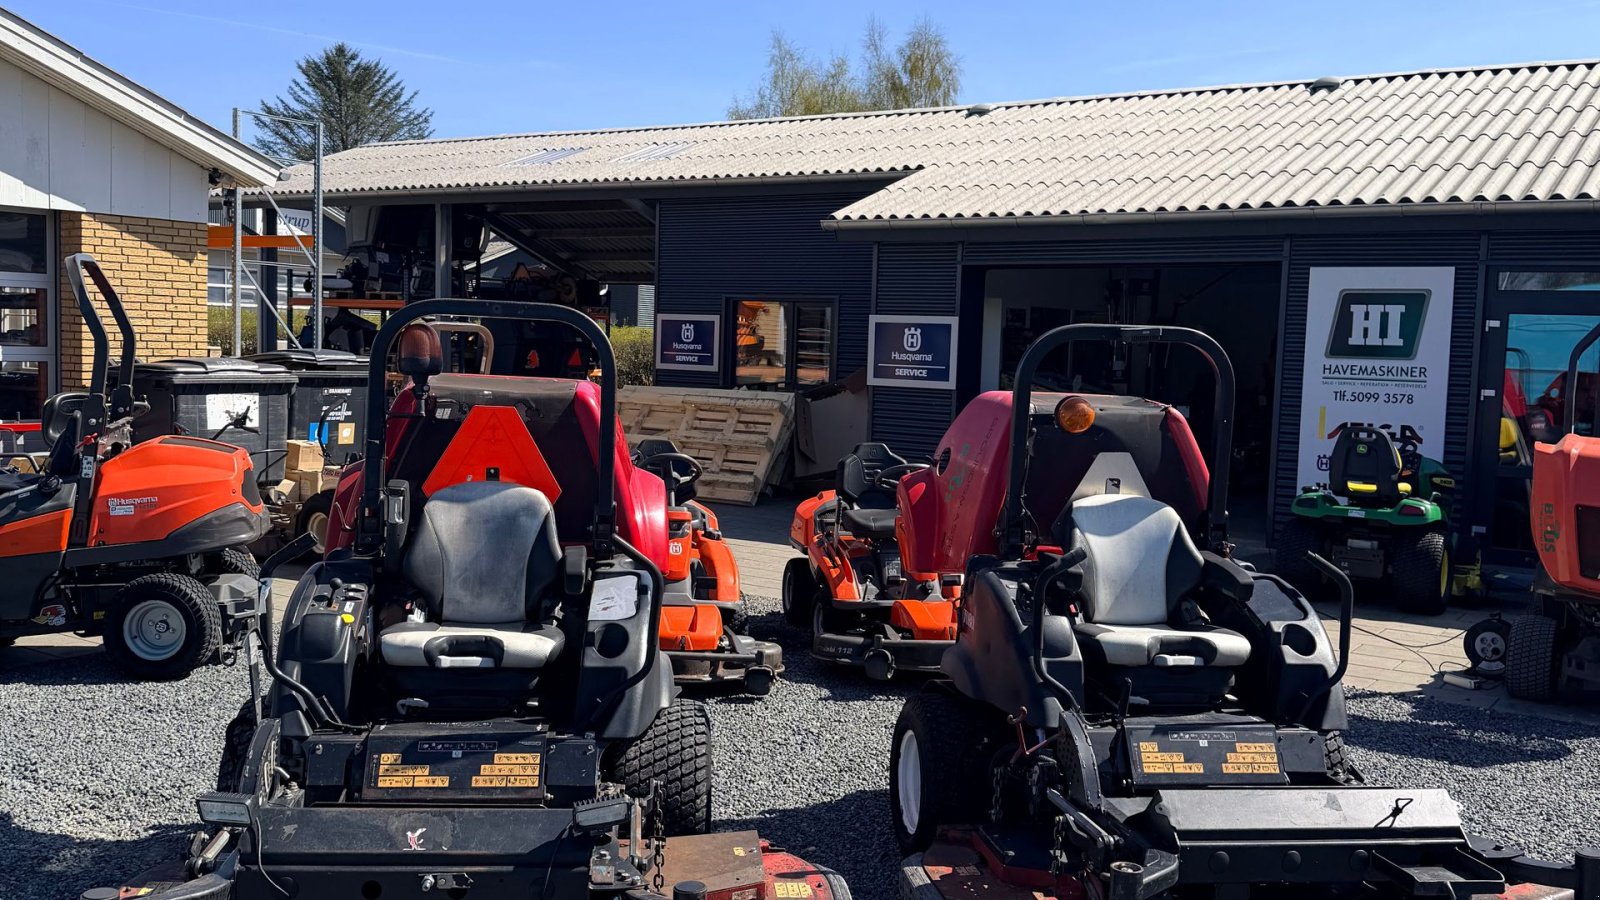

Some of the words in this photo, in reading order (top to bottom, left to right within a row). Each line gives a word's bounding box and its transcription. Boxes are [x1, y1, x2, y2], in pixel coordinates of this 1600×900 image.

[1348, 304, 1406, 347] HI
[672, 342, 702, 351] Husqvarna
[675, 355, 699, 363] SERVICE
[891, 351, 932, 362] Husqvarna
[894, 368, 928, 377] SERVICE
[1322, 364, 1428, 378] HAVEMASKINER
[1333, 390, 1380, 403] Tlf.5099
[1383, 393, 1415, 405] 3578
[116, 496, 158, 505] Husqvarna
